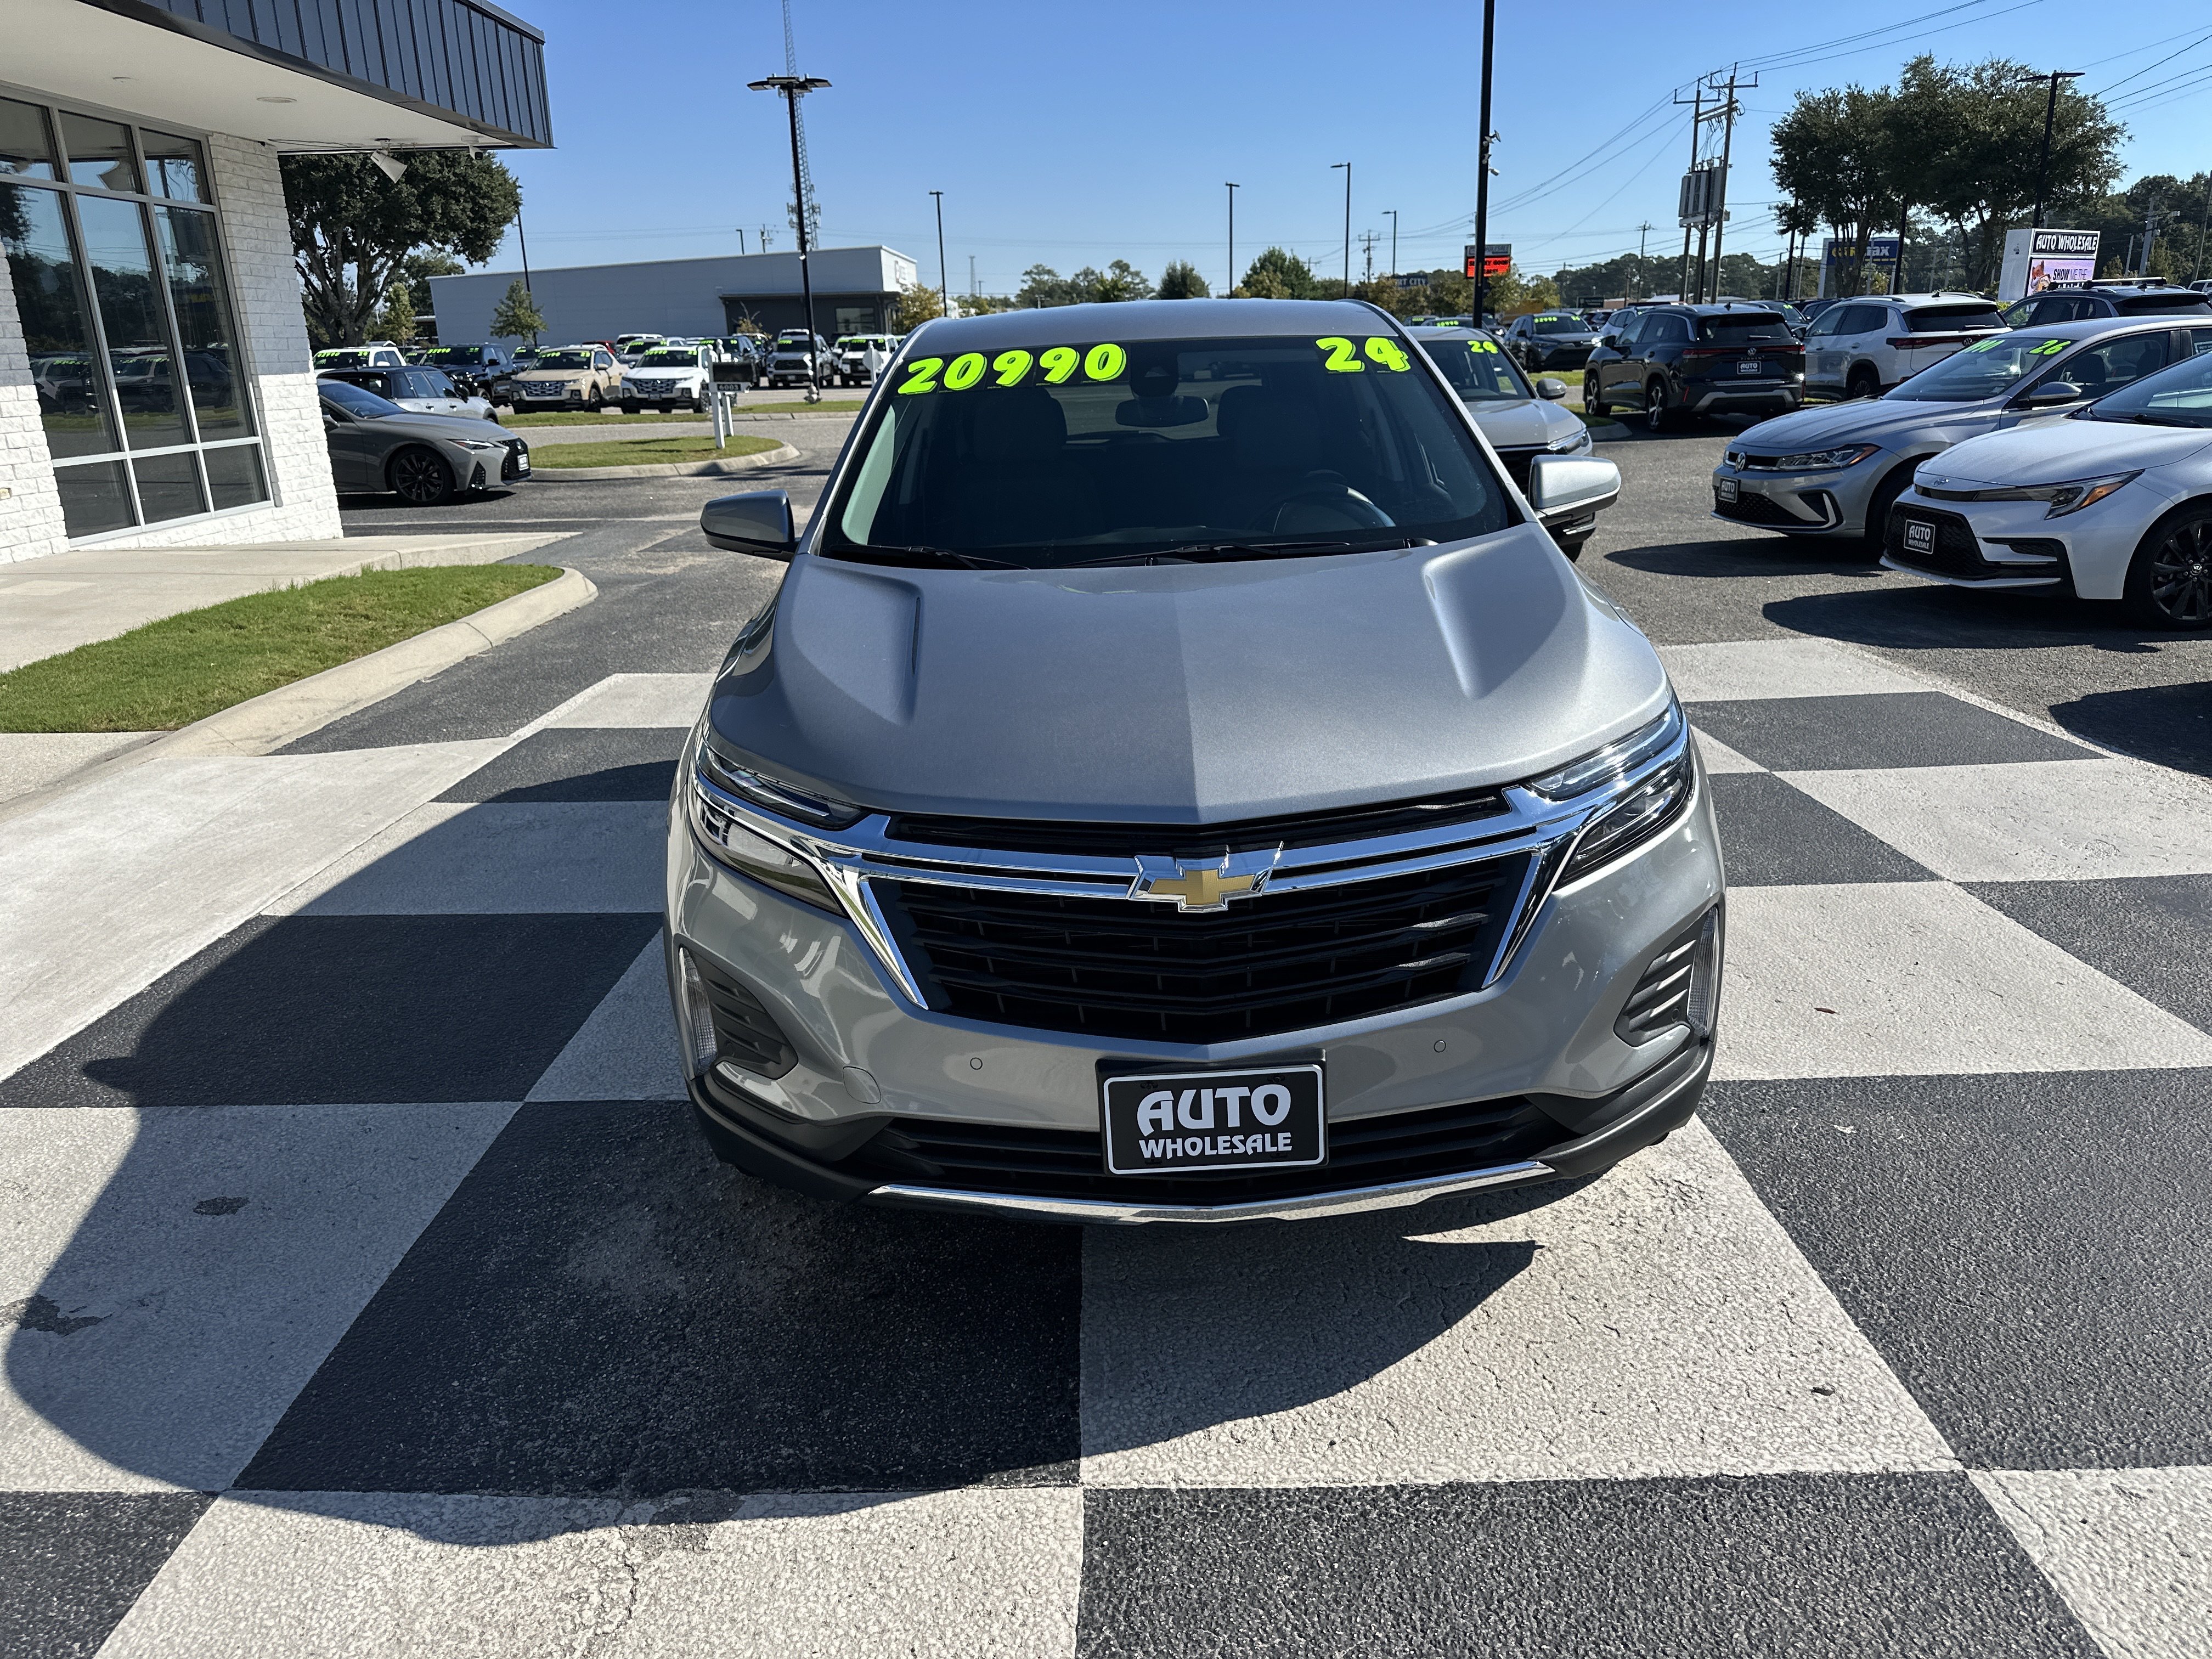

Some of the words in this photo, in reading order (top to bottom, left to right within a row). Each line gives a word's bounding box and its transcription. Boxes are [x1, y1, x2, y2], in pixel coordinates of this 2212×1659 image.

[2036, 234, 2057, 251] AUTO
[2058, 235, 2097, 252] WHOLESALE
[2052, 268, 2070, 281] SHOW
[1316, 337, 1411, 372] 24
[1467, 341, 1498, 354] 24
[2029, 340, 2072, 356] 26
[898, 343, 1127, 395] 20990
[1721, 481, 1735, 493] AUTO
[1909, 525, 1931, 541] AUTO
[1137, 1084, 1291, 1137] AUTO
[1138, 1132, 1293, 1160] WHOLESALE
